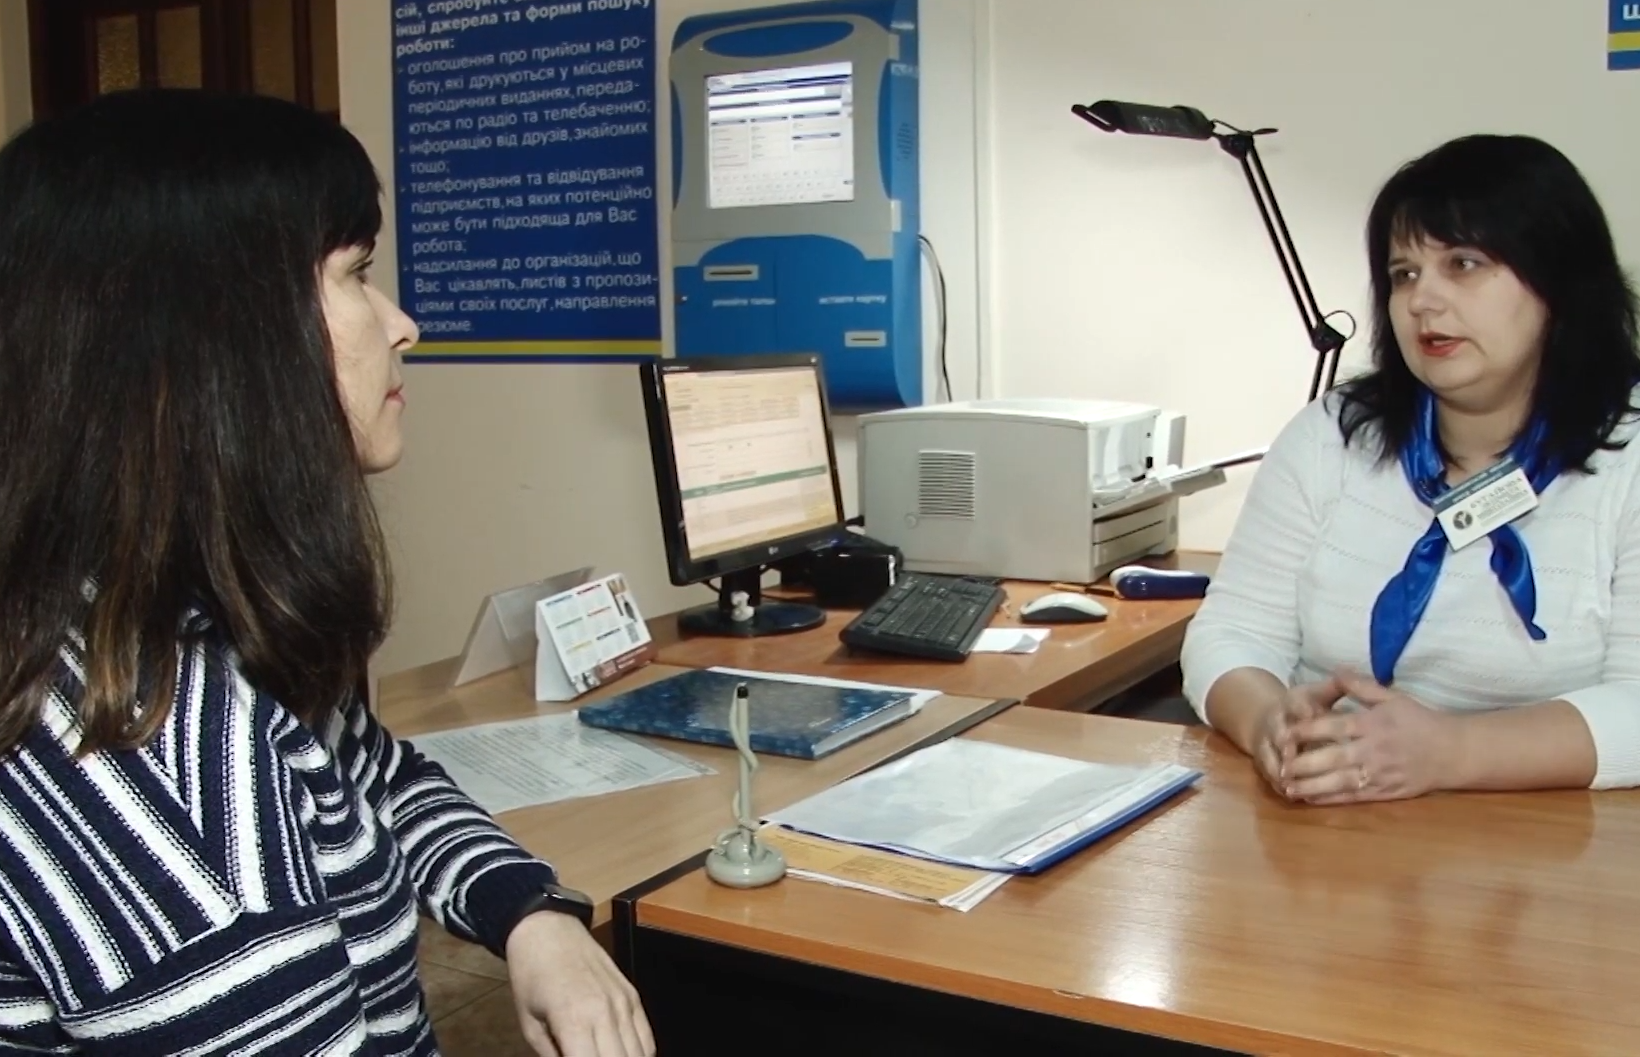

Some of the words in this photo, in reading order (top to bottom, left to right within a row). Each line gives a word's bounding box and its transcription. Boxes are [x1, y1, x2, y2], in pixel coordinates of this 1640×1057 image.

[395, 4, 422, 19] сій,
[396, 21, 425, 37] інші
[430, 13, 498, 34] джерела
[504, 11, 521, 22] та
[525, 4, 582, 23] форми
[588, 0, 650, 13] пошуку
[396, 39, 455, 57] роботи:
[408, 54, 494, 75] оголошення
[500, 51, 527, 64] про
[532, 41, 590, 60] прийом
[596, 39, 614, 52] на
[621, 35, 646, 51] ро-
[470, 70, 555, 90] друкуються
[560, 67, 568, 81] у
[574, 58, 644, 76] місцевих
[409, 96, 496, 115] періодичних
[409, 117, 451, 134] ються
[455, 117, 474, 129] по
[478, 112, 517, 130] радіо
[523, 112, 537, 123] та
[410, 135, 492, 155] інформацію
[497, 132, 517, 146] від
[410, 161, 450, 175] тощо;
[411, 175, 521, 195] телефонування
[527, 173, 543, 185] та
[547, 165, 644, 189] відвідування
[528, 194, 561, 206] яких
[566, 185, 652, 205] потенційно
[412, 219, 450, 232] може
[455, 217, 487, 235] бути
[492, 213, 570, 232] підходяща
[575, 211, 602, 227] для
[608, 207, 637, 222] Вас
[413, 238, 467, 255] робота;
[414, 257, 497, 274] надсилання
[502, 257, 520, 271] до
[415, 279, 440, 293] Вас
[572, 276, 581, 288] з
[586, 273, 658, 291] пропози-
[416, 297, 454, 314] ціями
[459, 296, 496, 312] своїх
